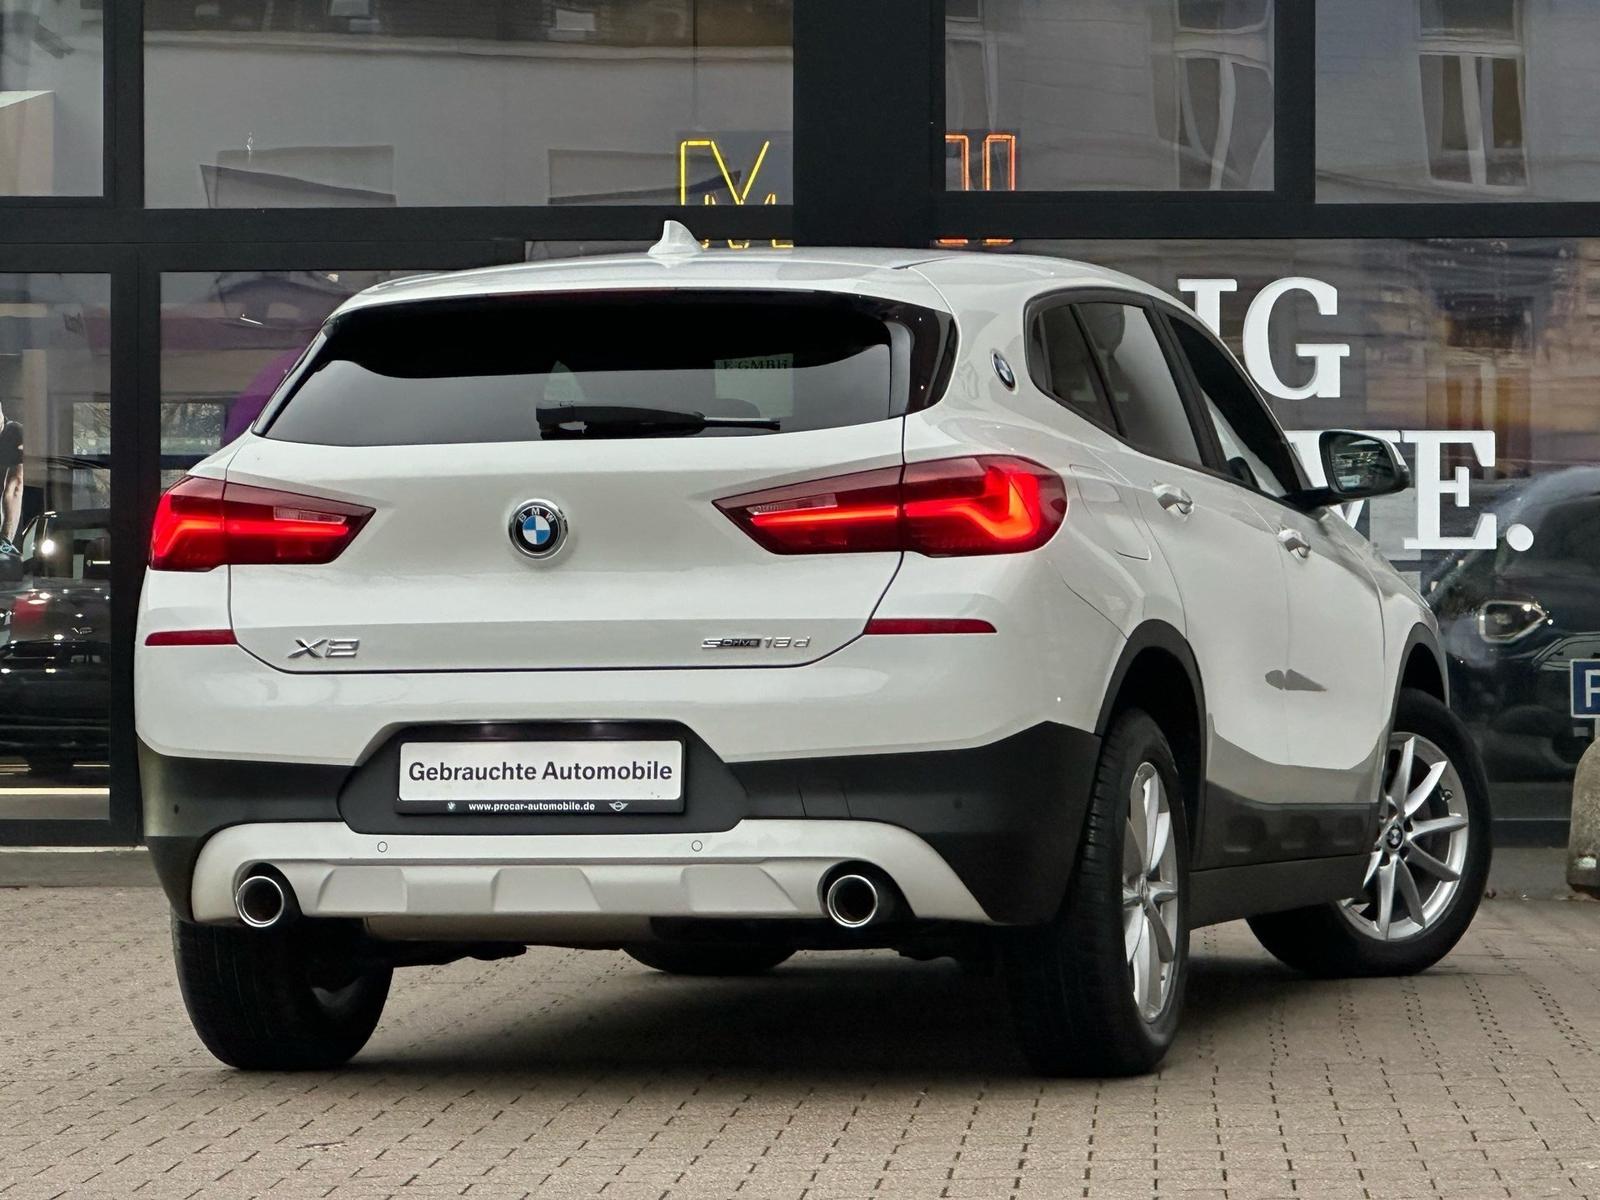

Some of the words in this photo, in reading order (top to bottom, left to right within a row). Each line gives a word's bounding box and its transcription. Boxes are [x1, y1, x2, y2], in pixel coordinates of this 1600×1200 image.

[287, 638, 361, 659] X2
[408, 761, 537, 782] Gebrauchte
[542, 760, 673, 781] Automobile
[468, 801, 596, 812] www.procar-automobile.de
